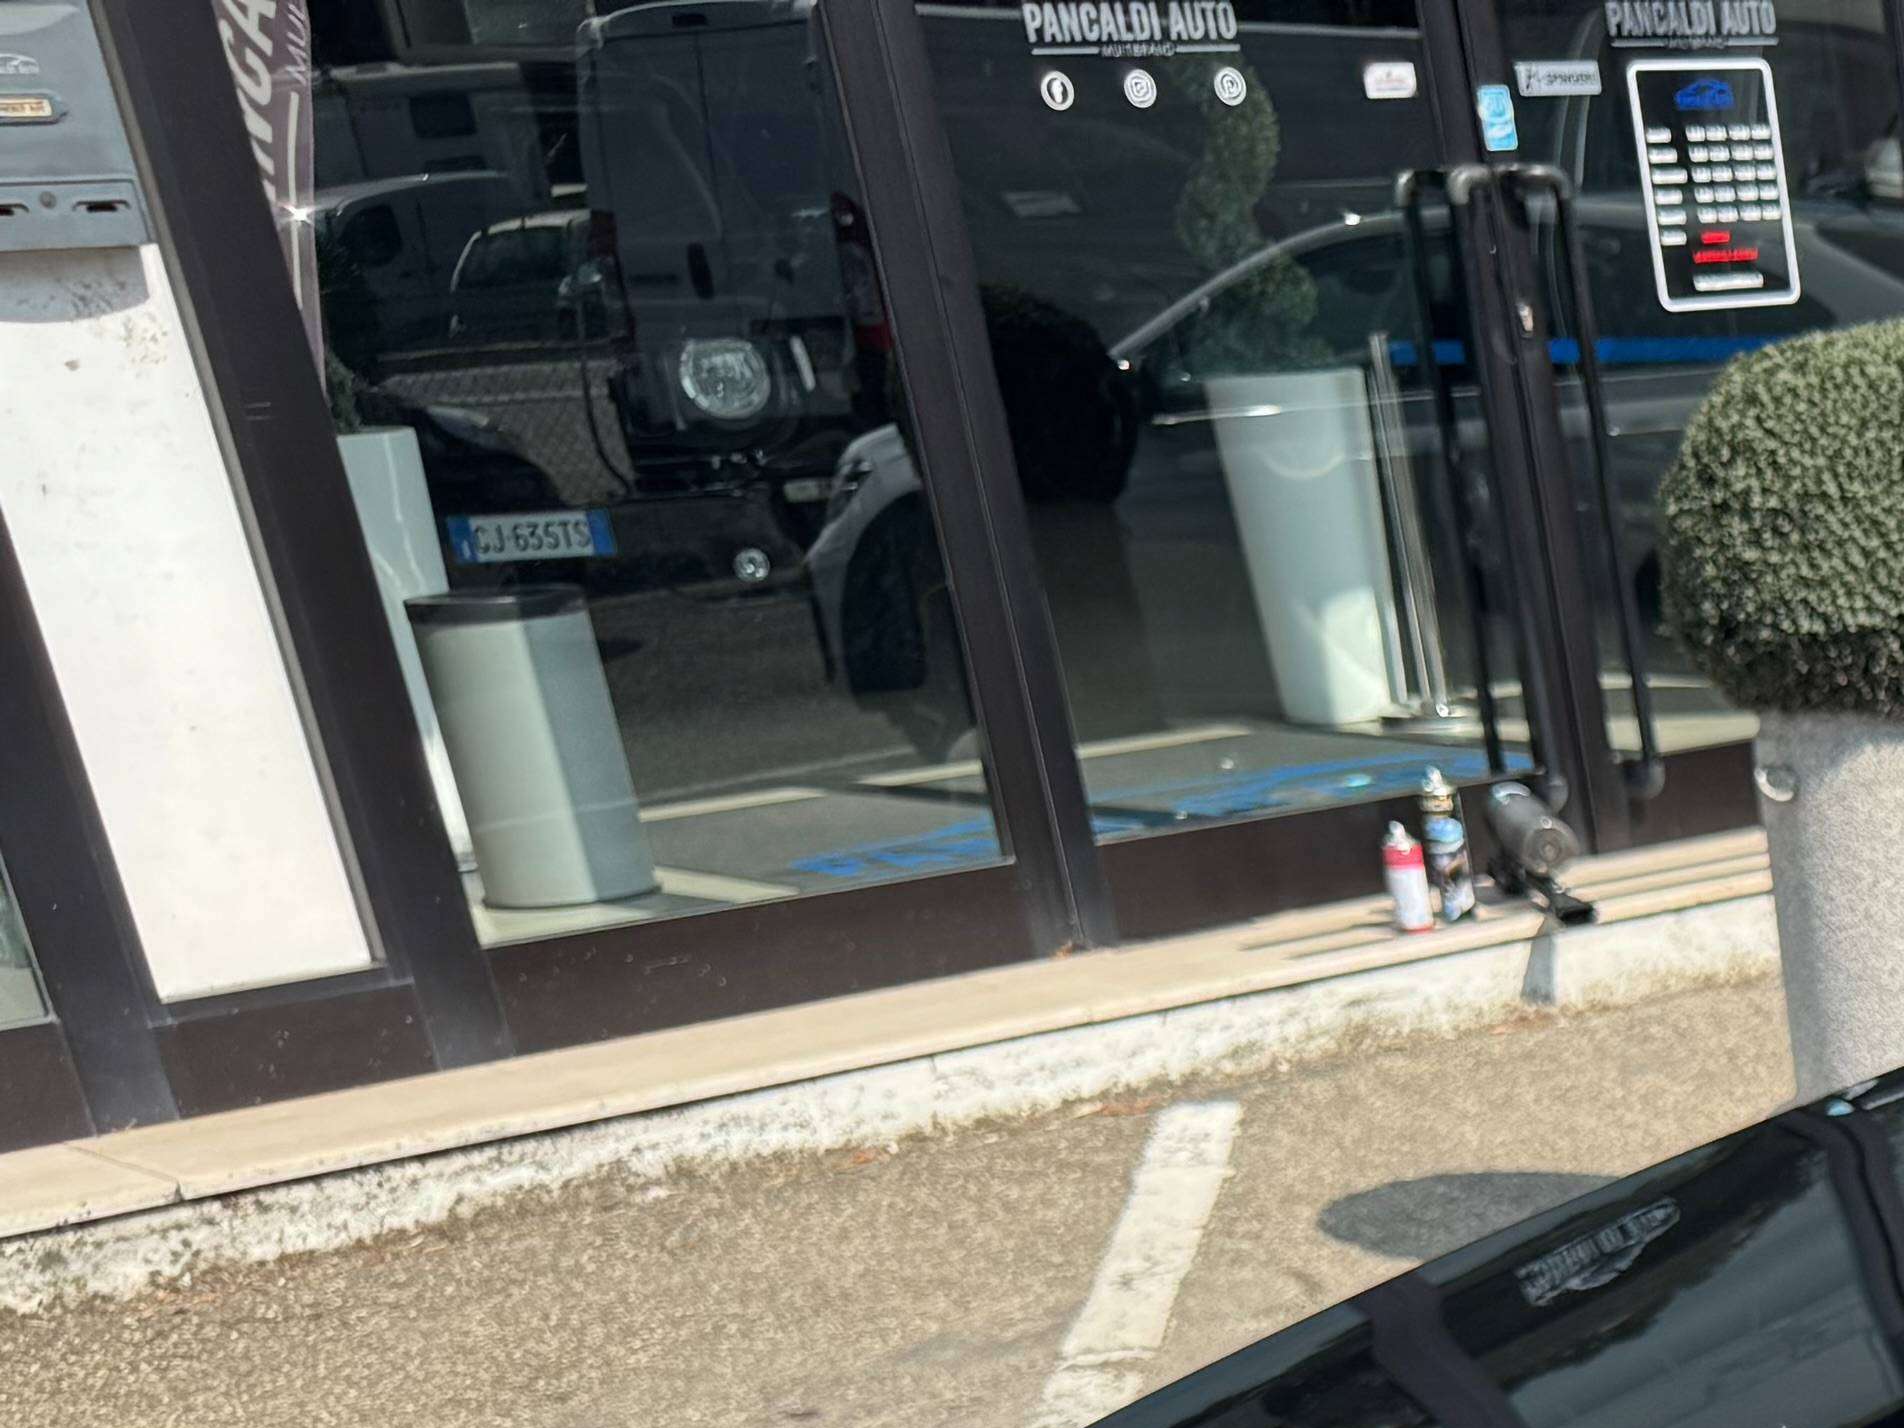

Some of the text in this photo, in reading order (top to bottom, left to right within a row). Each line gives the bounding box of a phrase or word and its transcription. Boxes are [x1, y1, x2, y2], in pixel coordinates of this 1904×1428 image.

[1022, 1, 1238, 43] PANCALDI AUTO
[1605, 0, 1777, 37] PANCALDI AUTO
